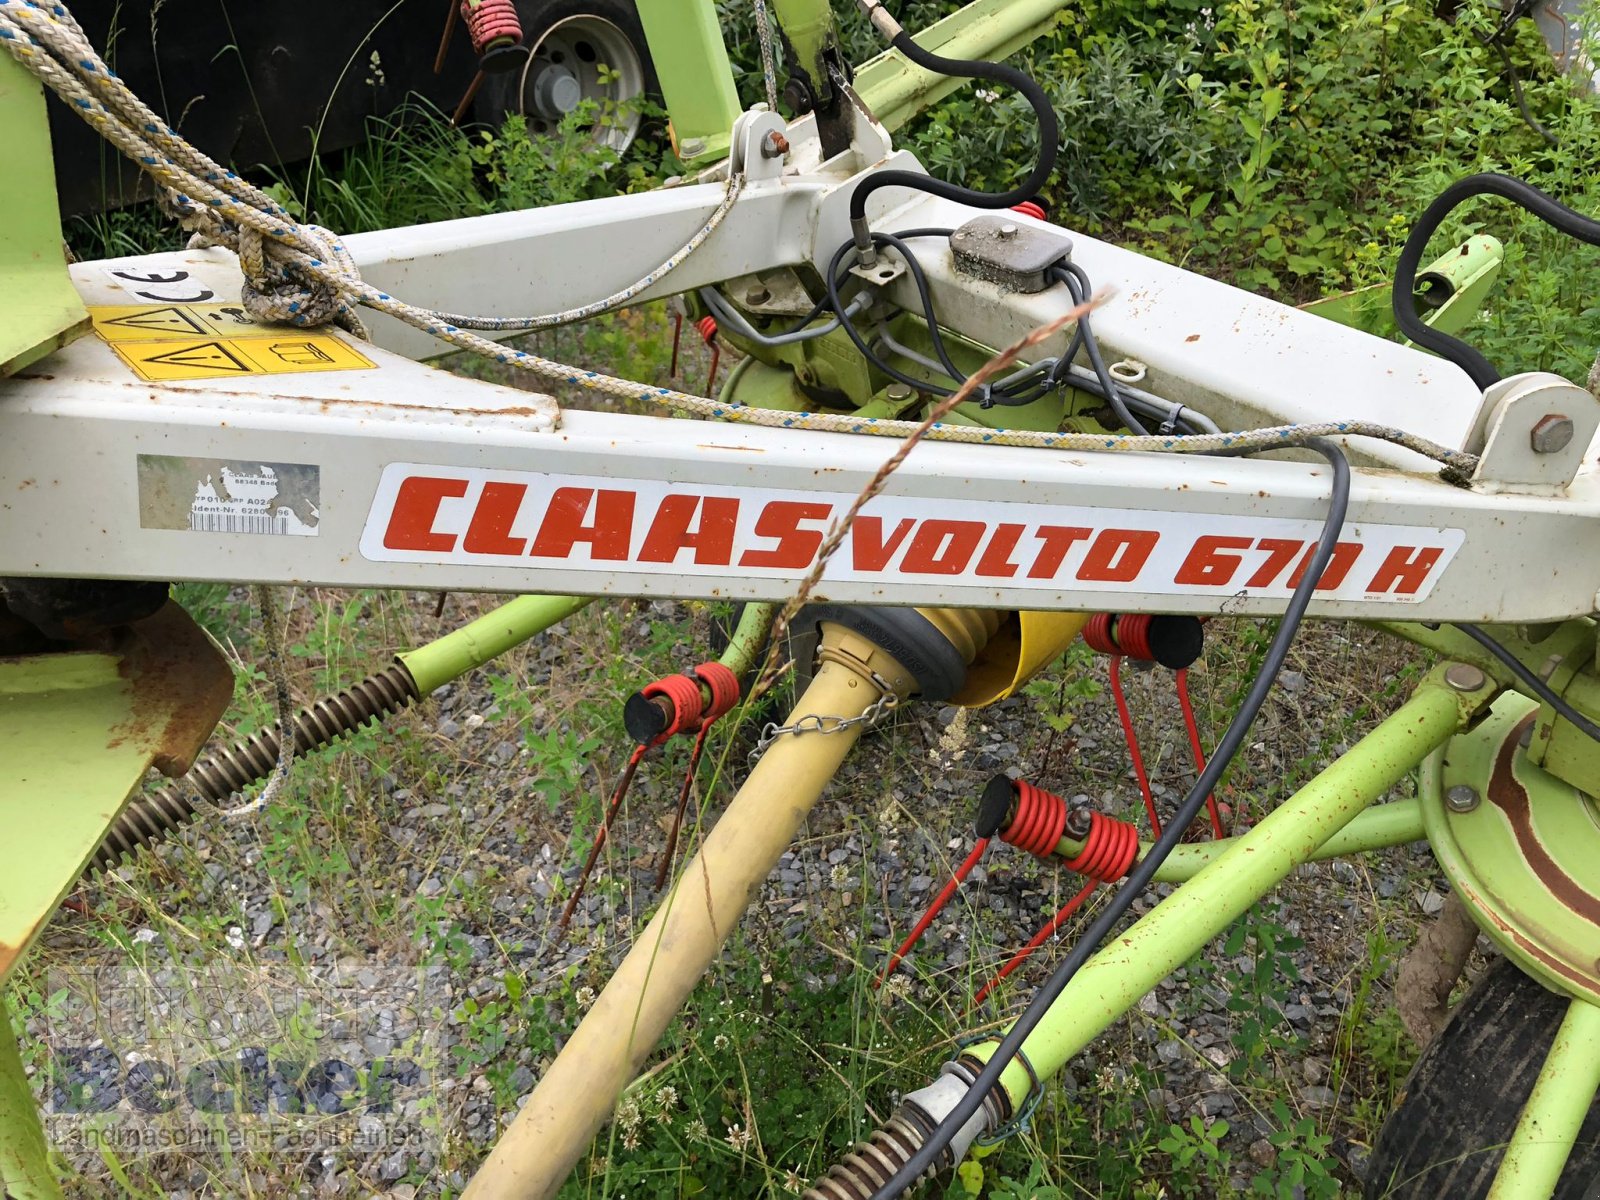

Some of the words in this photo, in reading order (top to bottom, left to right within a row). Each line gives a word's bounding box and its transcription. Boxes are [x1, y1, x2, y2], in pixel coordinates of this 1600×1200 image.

[194, 505, 238, 514] Ident-Nr.
[385, 477, 831, 568] CLAAS
[852, 515, 1159, 581] VOLTO
[1174, 535, 1363, 590] 670
[1365, 546, 1444, 594] H
